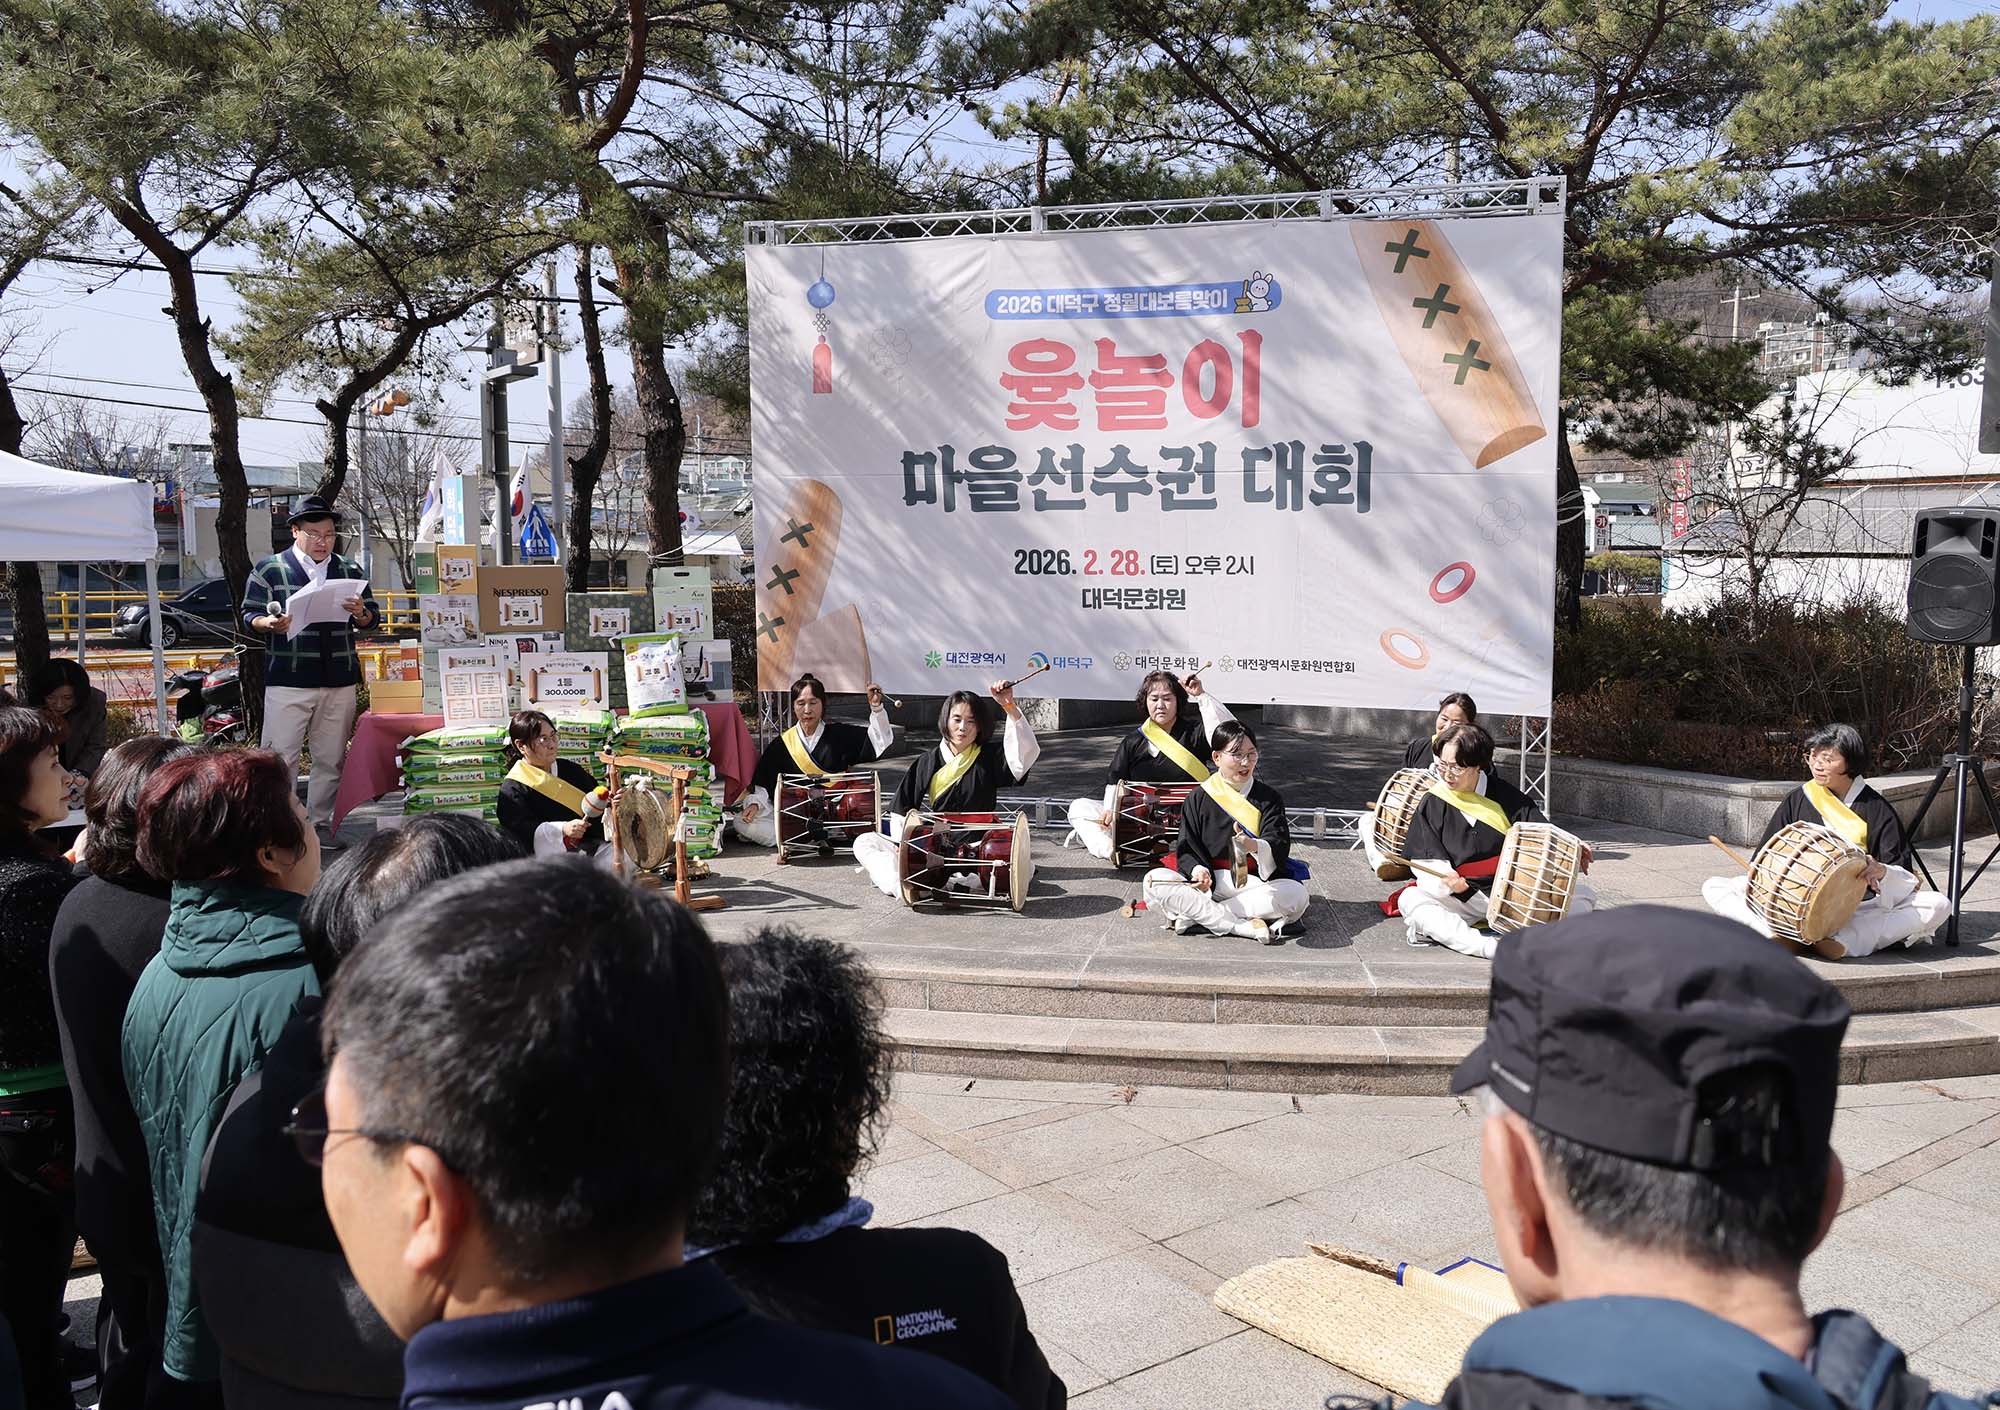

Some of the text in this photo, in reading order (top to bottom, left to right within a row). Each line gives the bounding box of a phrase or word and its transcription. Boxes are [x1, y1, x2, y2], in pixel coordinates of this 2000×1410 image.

[996, 288, 1228, 315] 2026 대덕구 정월대보름맞이
[999, 328, 1264, 432] 윷놀이
[901, 439, 1375, 514] 마을선수권 대회
[1013, 548, 1077, 577] 2026.
[1083, 549, 1105, 577] 2.
[1110, 549, 1146, 577] 28.
[1184, 555, 1222, 577] 오후
[1226, 555, 1255, 576] 2시
[493, 587, 549, 597] NESPRESSO
[1081, 588, 1187, 611] 대덕문화원
[488, 638, 509, 647] NINJA
[945, 652, 1006, 666] 대전광역시
[1053, 655, 1093, 669] 대덕구
[1134, 655, 1200, 671] 대덕문화원
[1236, 658, 1356, 674] 대전광역시문화원연합회
[896, 1308, 944, 1327] NATIONAL
[896, 1318, 957, 1339] GEOGRAPHIC
